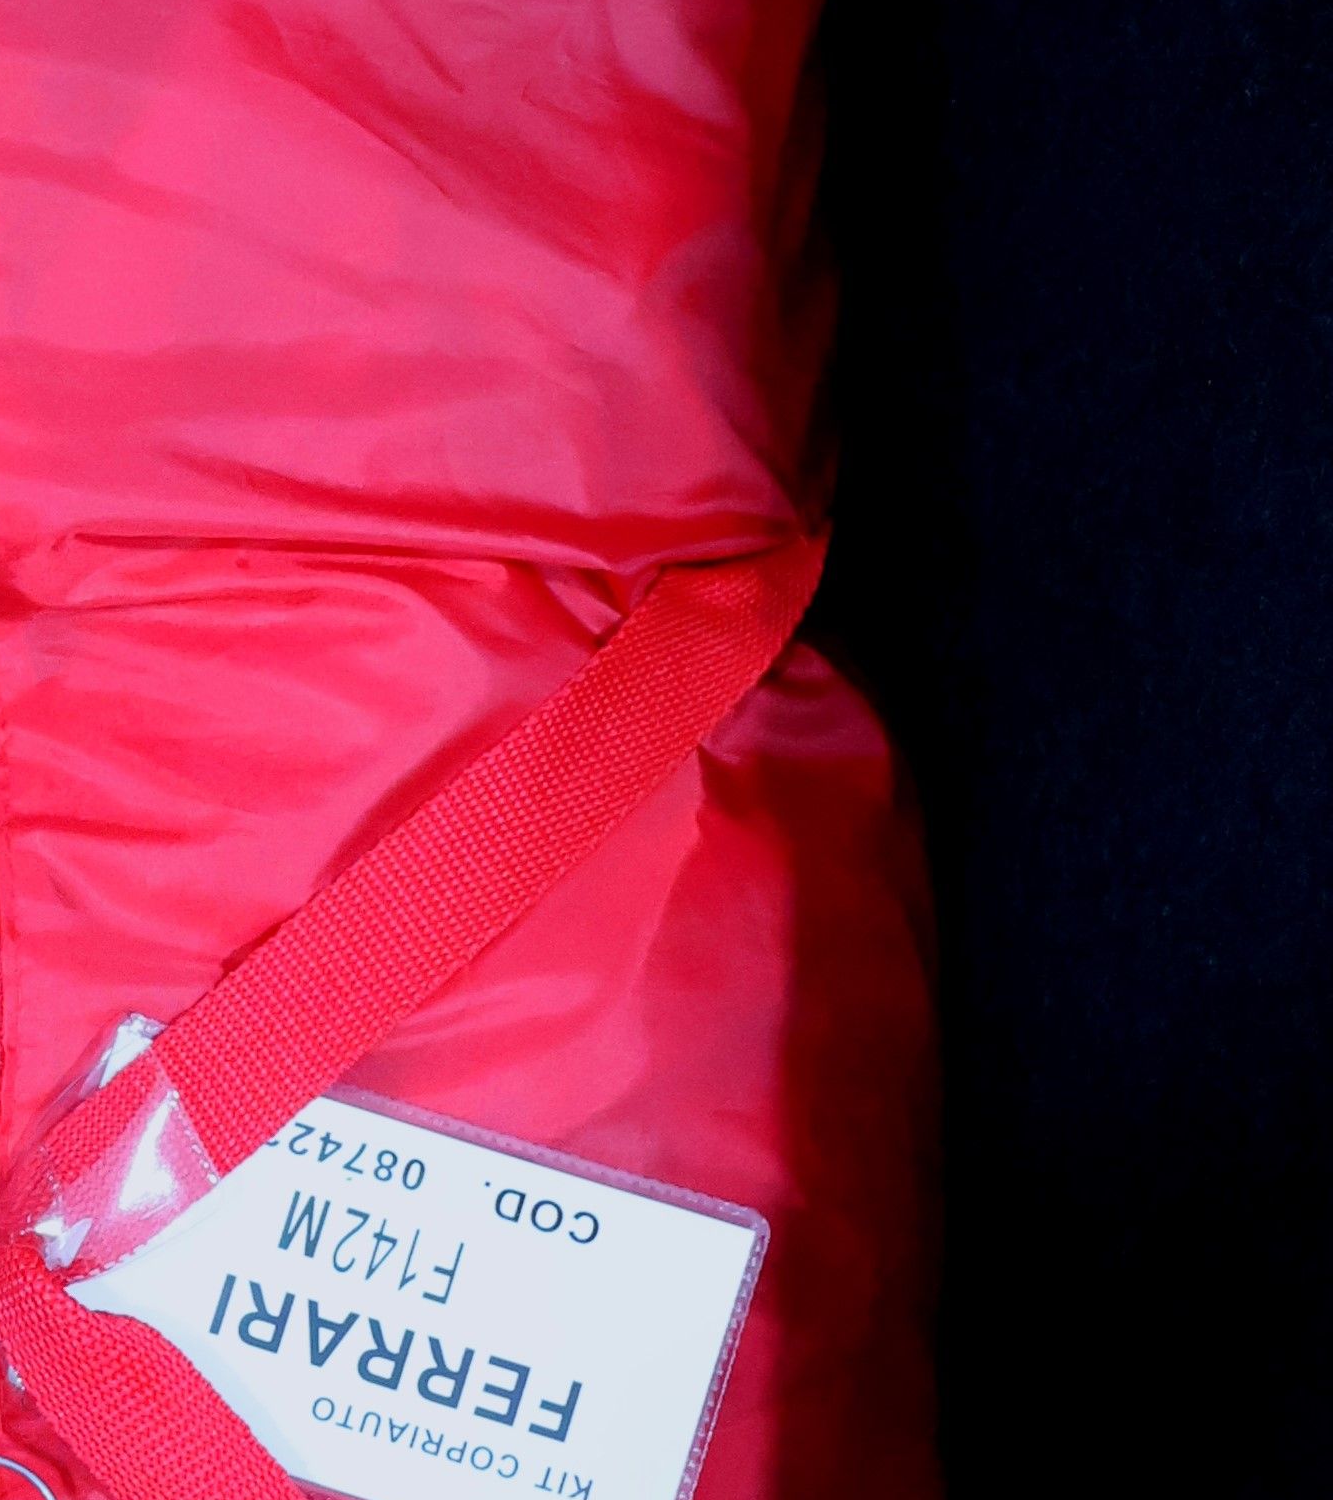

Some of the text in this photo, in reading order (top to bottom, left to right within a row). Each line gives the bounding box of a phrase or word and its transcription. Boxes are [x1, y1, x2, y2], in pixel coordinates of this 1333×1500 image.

[265, 1122, 600, 1246] COD. 08742
[277, 1190, 466, 1306] F142M
[208, 1273, 584, 1444] FERRARI
[312, 1397, 520, 1480] COPRIAUTO
